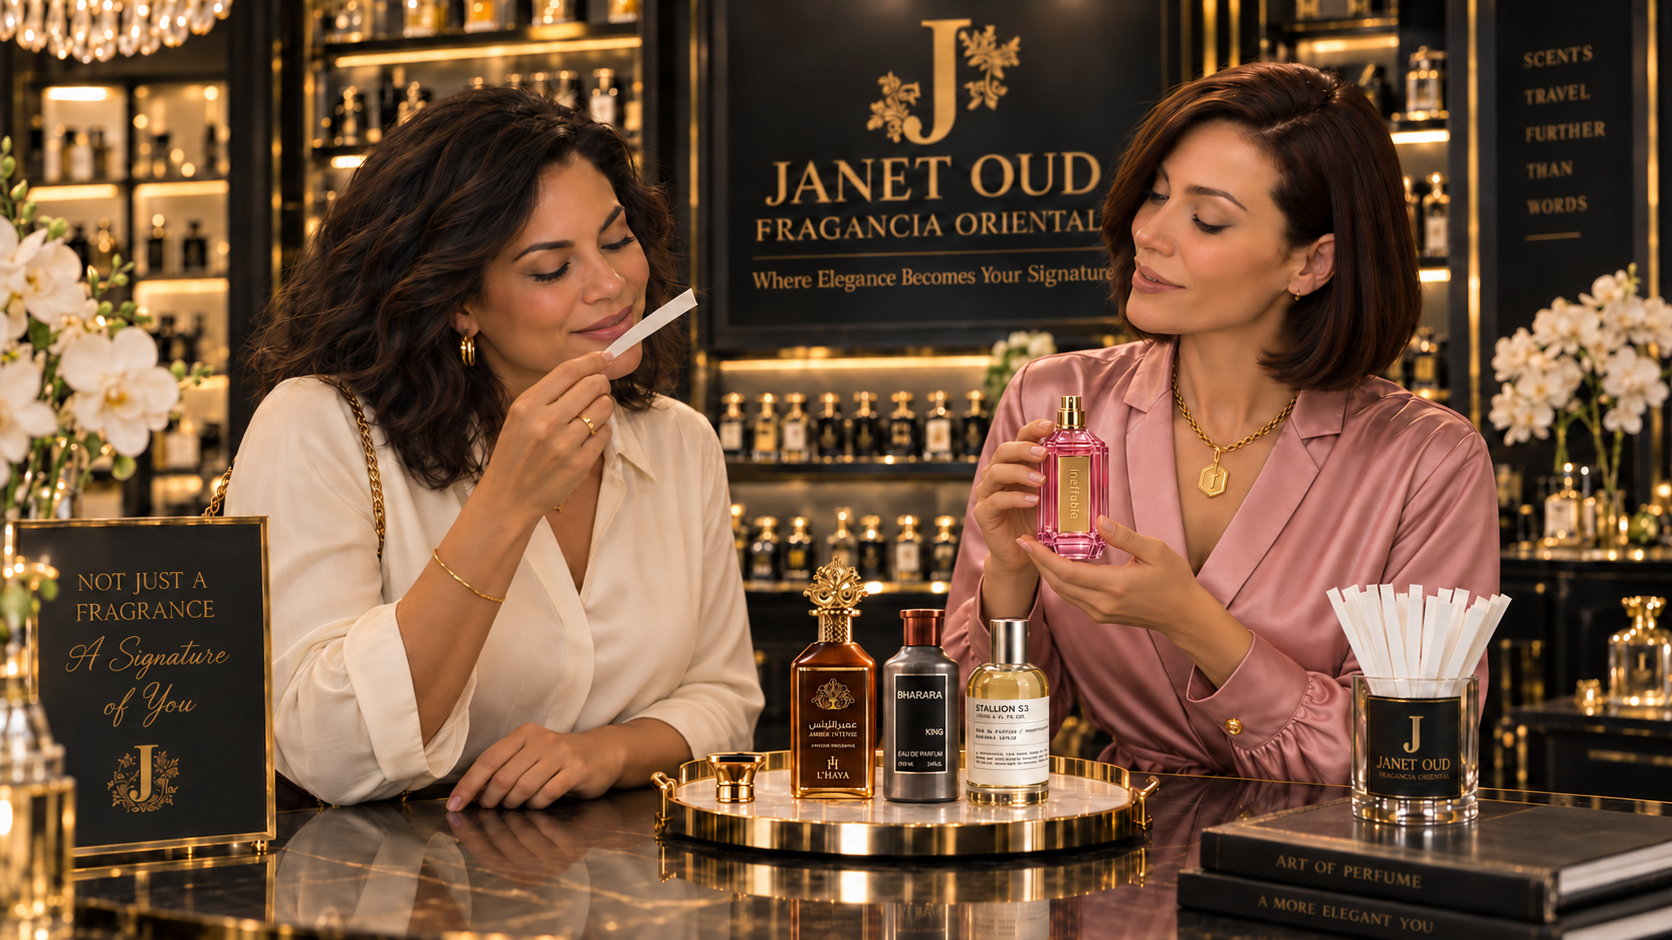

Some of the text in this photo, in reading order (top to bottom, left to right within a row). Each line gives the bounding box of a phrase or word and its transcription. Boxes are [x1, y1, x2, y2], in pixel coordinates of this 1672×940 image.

[1523, 44, 1594, 69] SCENTS
[902, 18, 971, 145] J
[1524, 83, 1591, 106] TRAVEL
[1525, 120, 1606, 143] FURTHER
[765, 151, 1102, 207] JANET OUD
[1526, 160, 1574, 180] THAN
[1527, 195, 1589, 216] WORDS
[755, 208, 1103, 243] FRAGANCIA ORIENTAL
[752, 263, 1115, 293] Where Elegance Becomes Your Signature
[1069, 468, 1080, 520] ineffable
[77, 571, 208, 595] NOT JUST A
[76, 600, 215, 622] FRAGRANCE
[65, 635, 230, 680] A Signature
[103, 681, 197, 728] of You
[897, 690, 943, 700] BHARARA
[975, 704, 1030, 713] STALLION S3
[925, 728, 944, 736] KING
[1403, 715, 1424, 754] J
[897, 750, 943, 758] EAU DE PARFUM
[1376, 755, 1451, 771] JANET OUD
[129, 744, 159, 804] J
[816, 771, 850, 779] L'HAYA
[1275, 855, 1422, 889] ART OF PERFUME
[1257, 895, 1434, 934] A MORE ELEGANT YOU
